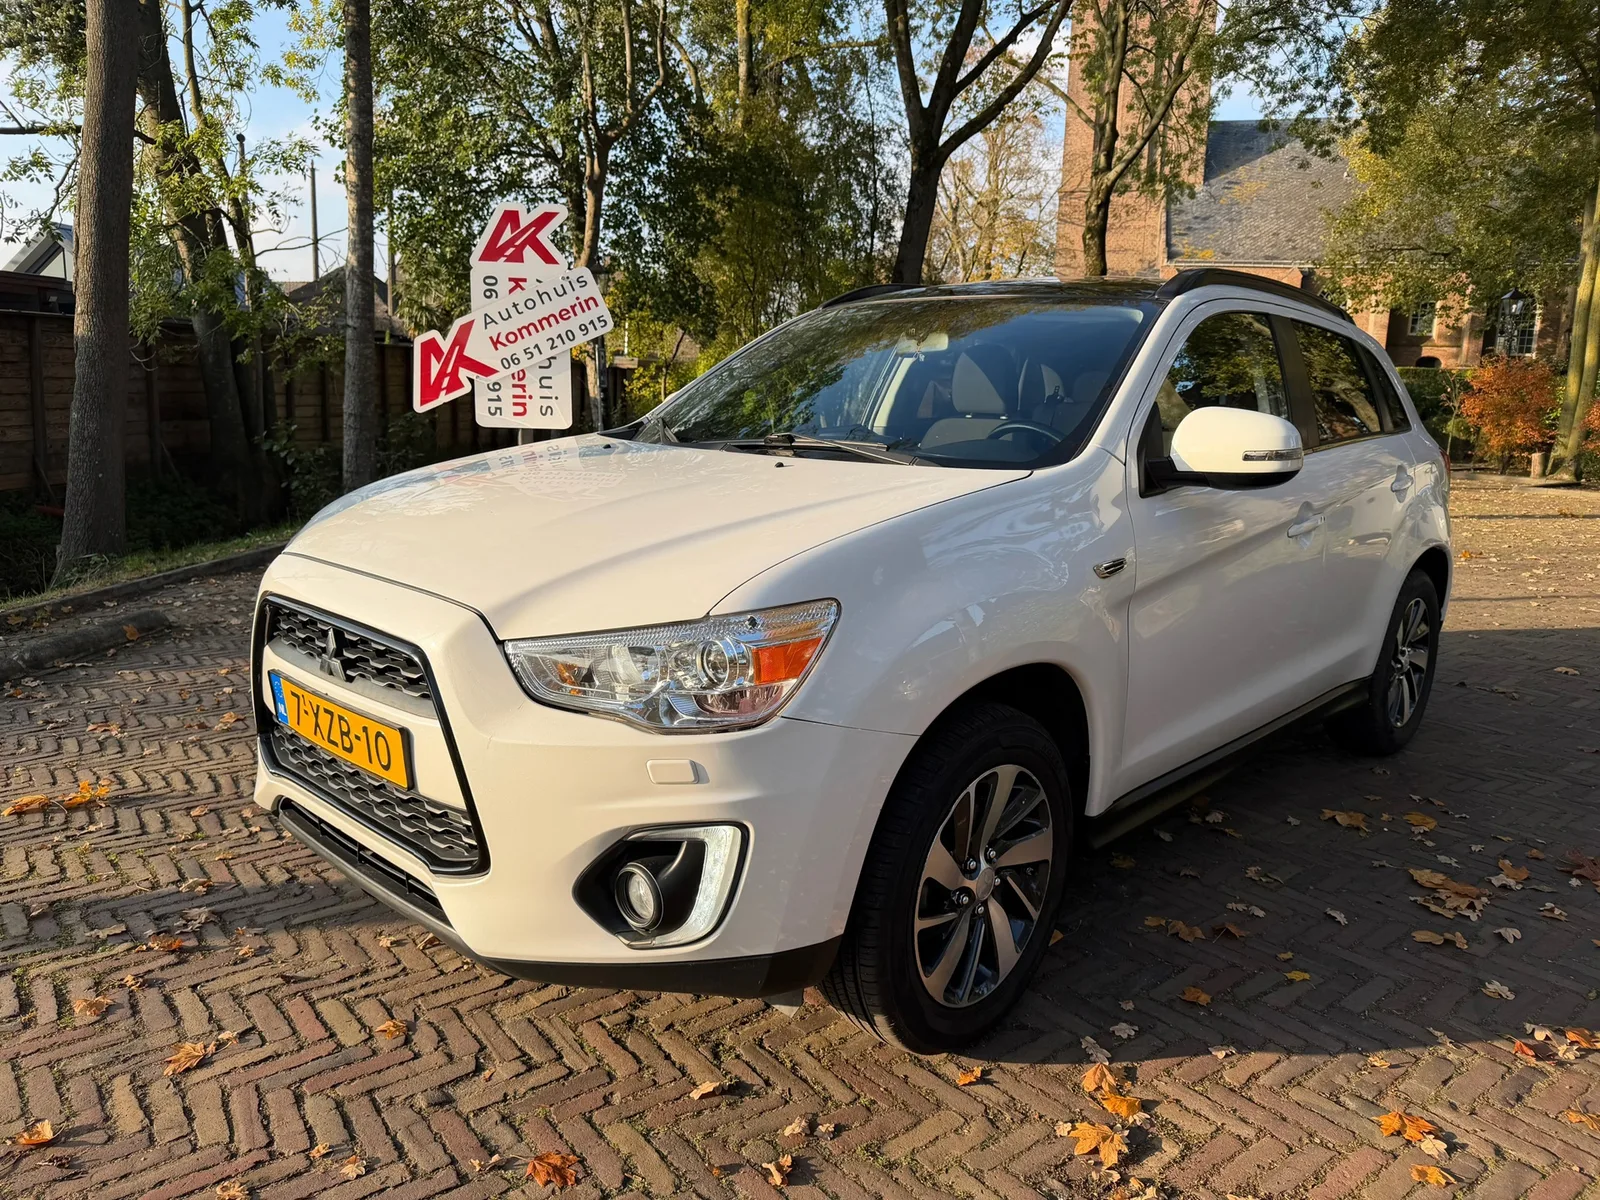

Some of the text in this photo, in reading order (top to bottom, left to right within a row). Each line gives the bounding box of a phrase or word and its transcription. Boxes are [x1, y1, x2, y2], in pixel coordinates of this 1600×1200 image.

[483, 275, 588, 330] Autohuis
[489, 296, 599, 351] Kommerin
[483, 275, 502, 416] 06 915
[501, 315, 608, 370] 06 51 210 915
[278, 702, 287, 716] NL
[290, 690, 392, 772] 7-XZB-10
